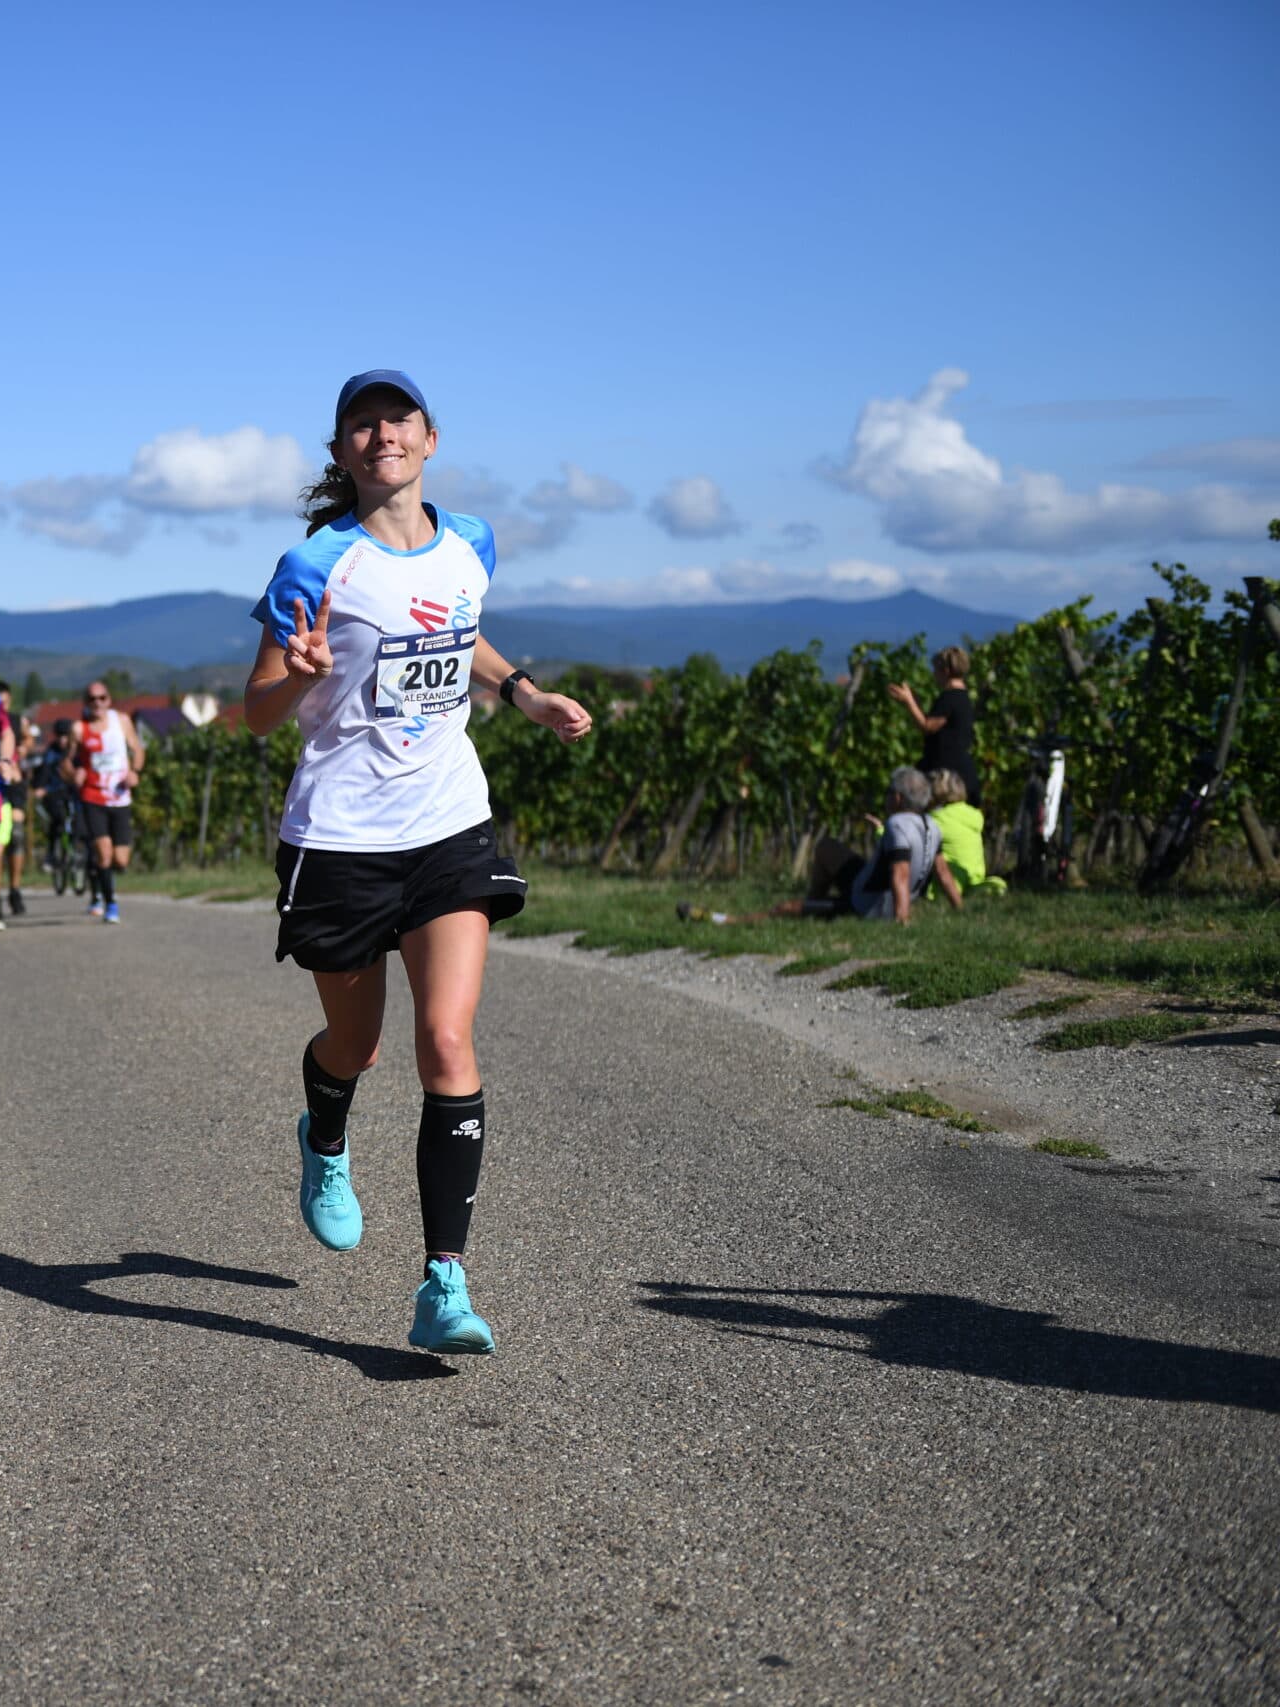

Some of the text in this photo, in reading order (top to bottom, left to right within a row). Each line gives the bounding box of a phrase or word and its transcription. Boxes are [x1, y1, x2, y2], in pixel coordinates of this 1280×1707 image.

[404, 657, 459, 691] 202
[403, 690, 457, 703] ALEXANDRA
[422, 698, 460, 714] MARATHON
